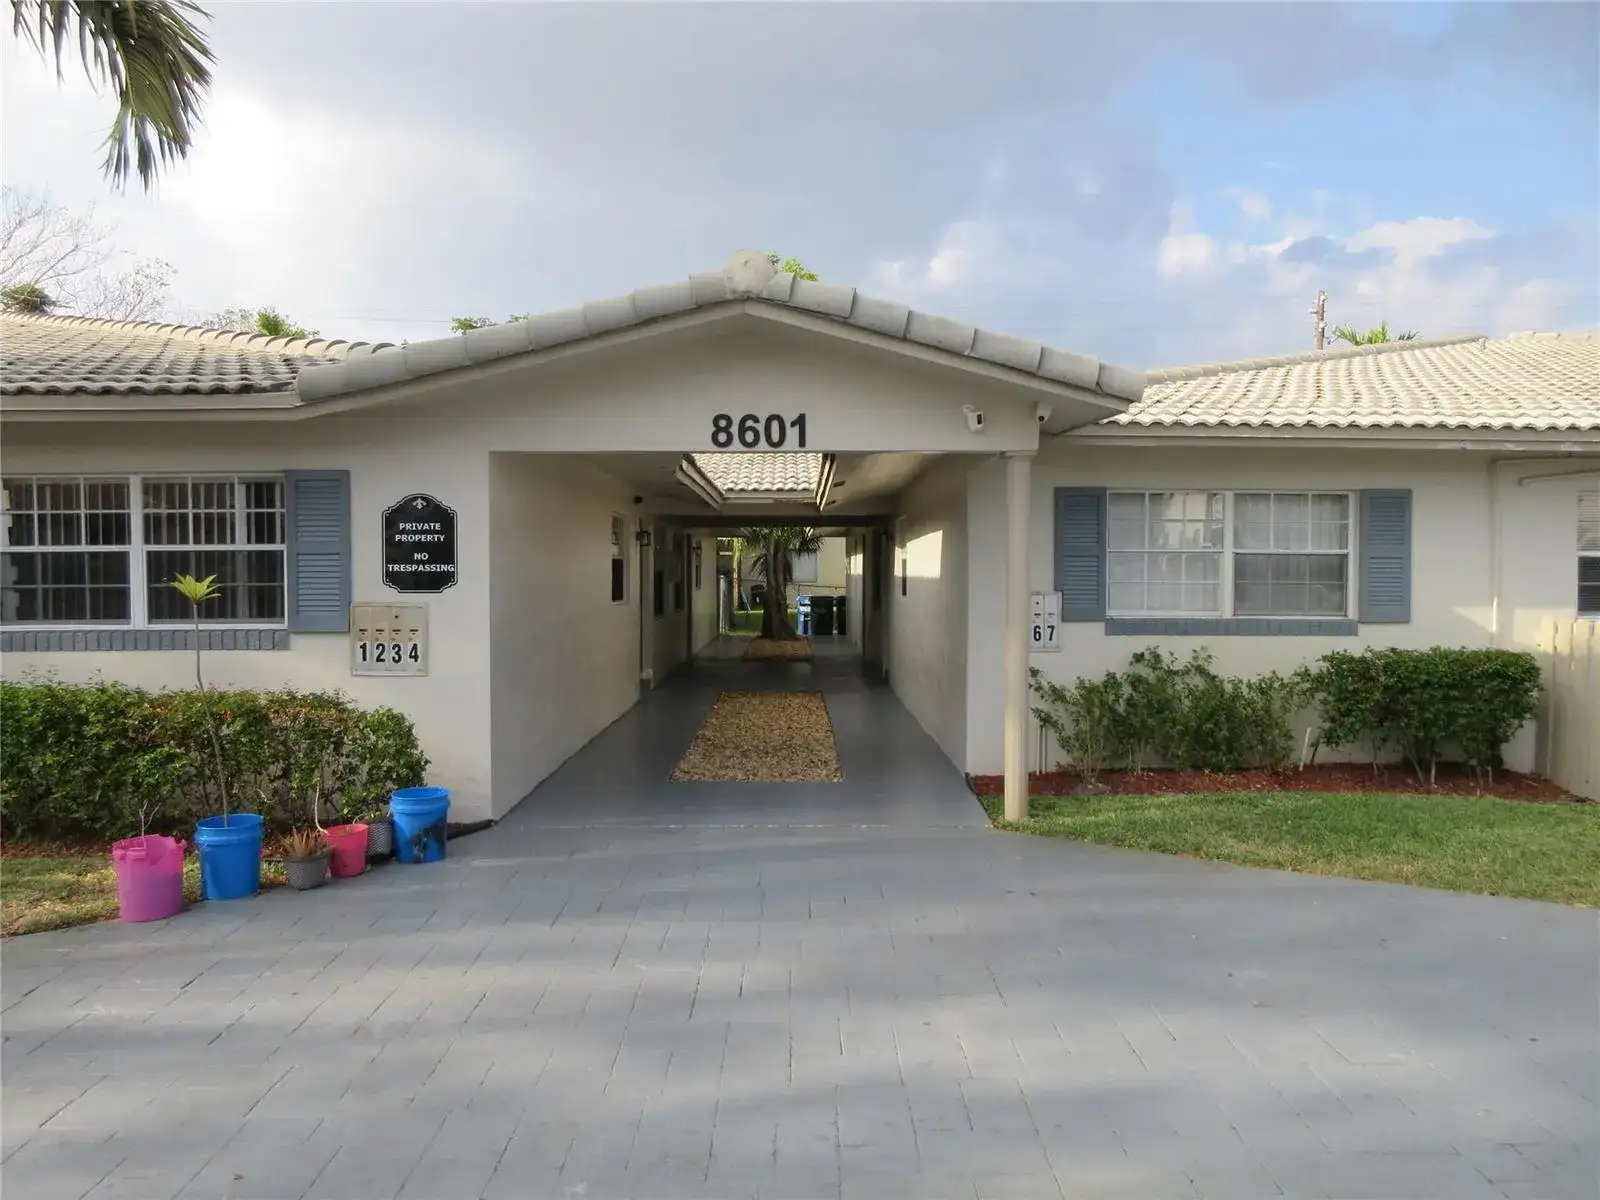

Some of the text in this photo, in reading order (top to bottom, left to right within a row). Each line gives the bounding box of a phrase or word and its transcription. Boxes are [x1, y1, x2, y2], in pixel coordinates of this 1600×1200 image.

[711, 413, 806, 448] 8601
[399, 522, 441, 531] PRIVATE
[395, 534, 446, 542] PROPERTY
[413, 552, 429, 561] NO
[387, 564, 455, 572] TRESPASSING
[1033, 624, 1056, 642] 6 7
[359, 642, 420, 664] 1 2 3 4
